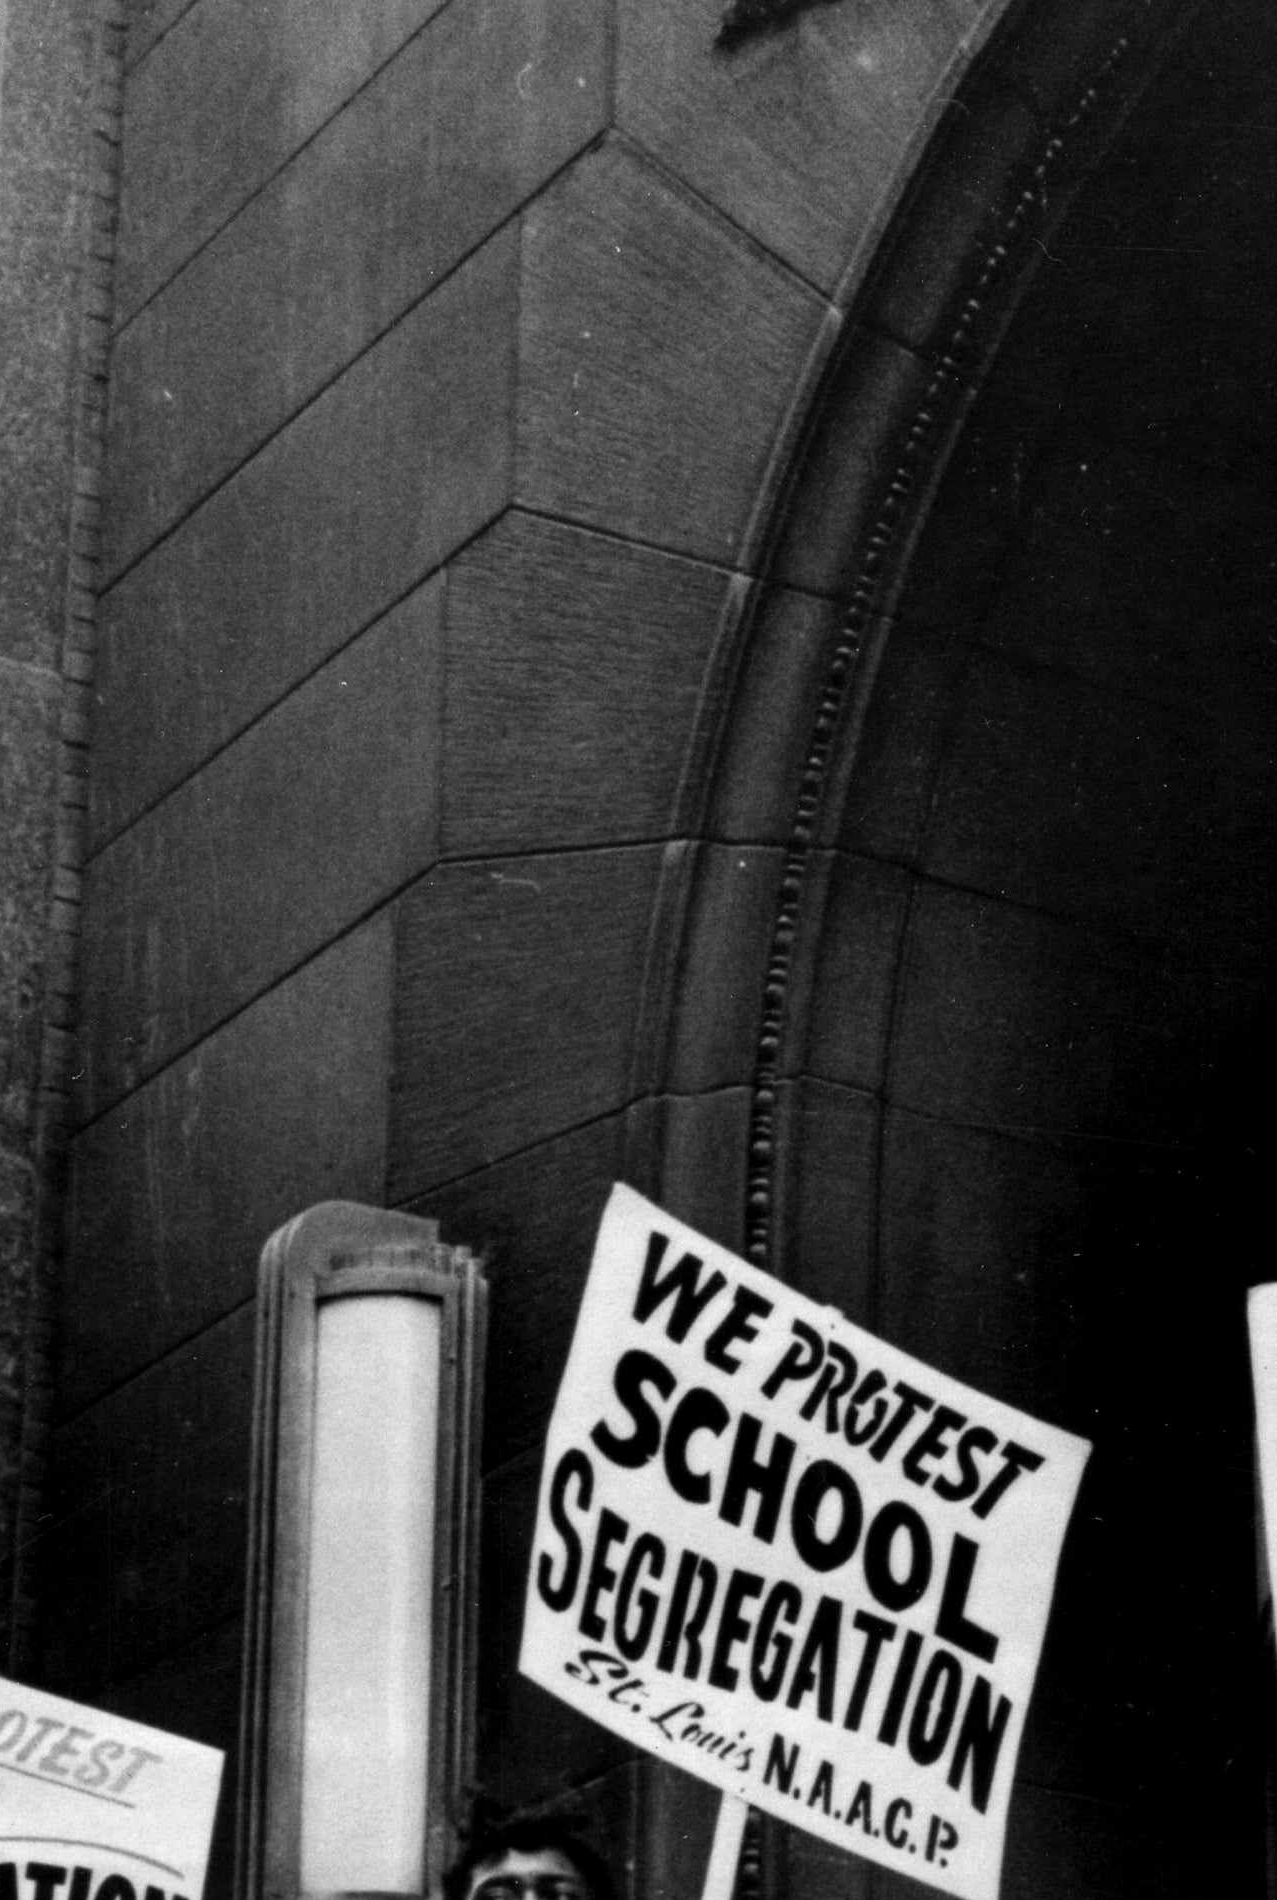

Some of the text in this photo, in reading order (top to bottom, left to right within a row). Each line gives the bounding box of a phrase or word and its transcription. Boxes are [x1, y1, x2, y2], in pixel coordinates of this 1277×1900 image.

[590, 1348, 1001, 1664] SCHOOL
[632, 1230, 1047, 1520] WE PROTEST
[536, 1448, 1013, 1816] SEGREGATION
[563, 1648, 960, 1869] St. Louis N.A.A.C.P.
